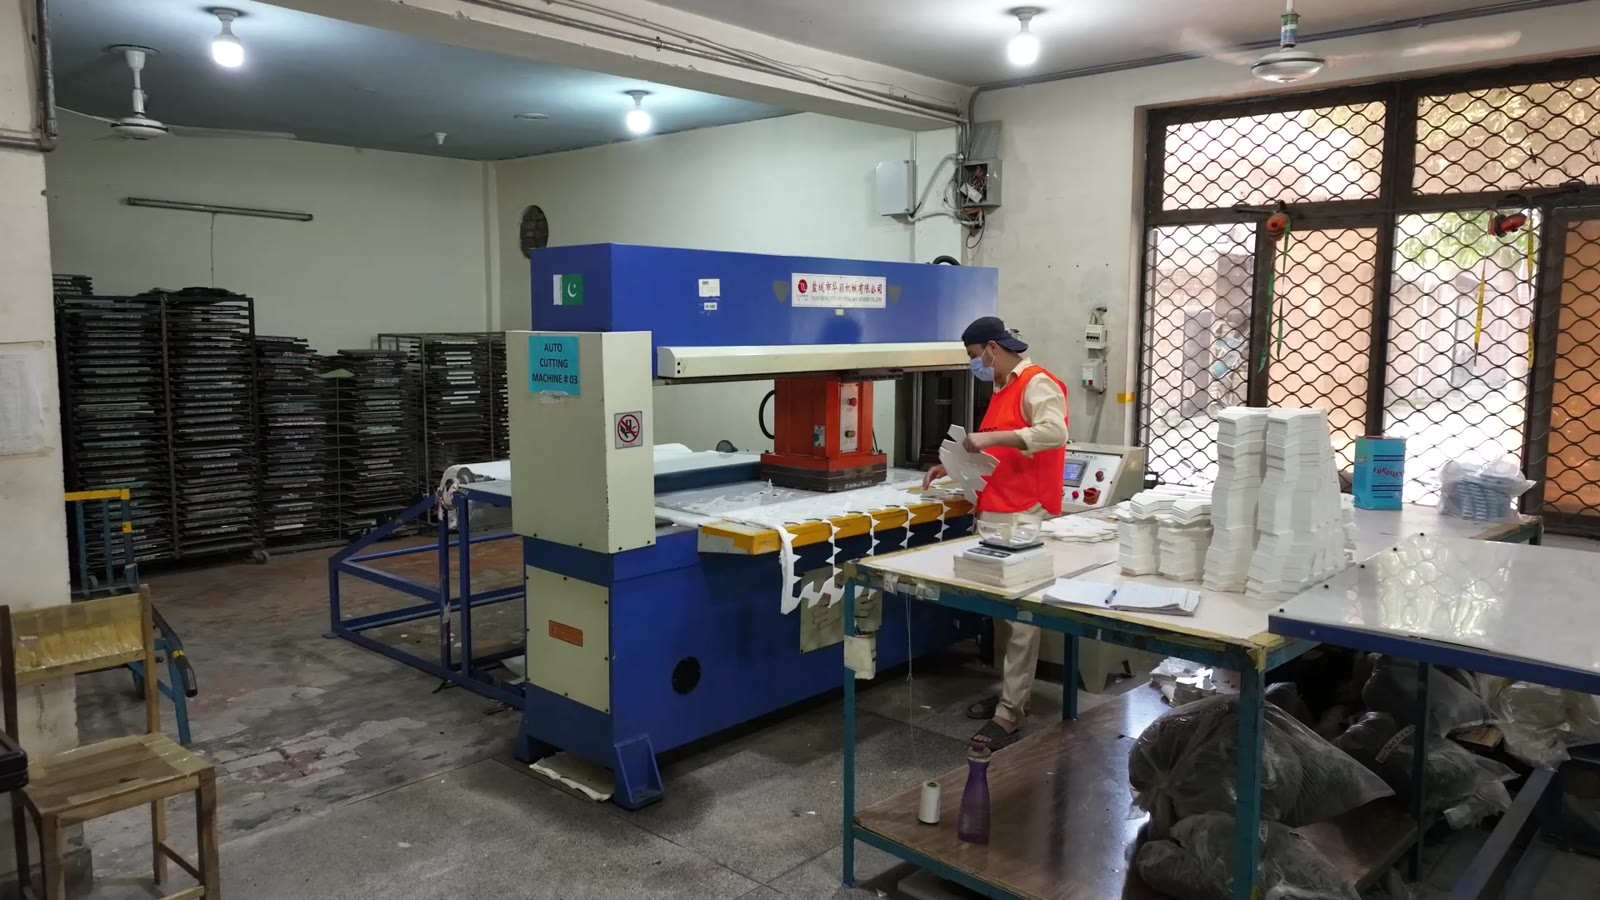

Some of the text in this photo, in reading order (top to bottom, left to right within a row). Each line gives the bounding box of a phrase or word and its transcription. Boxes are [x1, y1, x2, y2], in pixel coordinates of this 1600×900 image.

[544, 343, 563, 352] AUTO
[539, 358, 568, 368] CUTTING
[532, 373, 578, 384] MACHINE # 03
